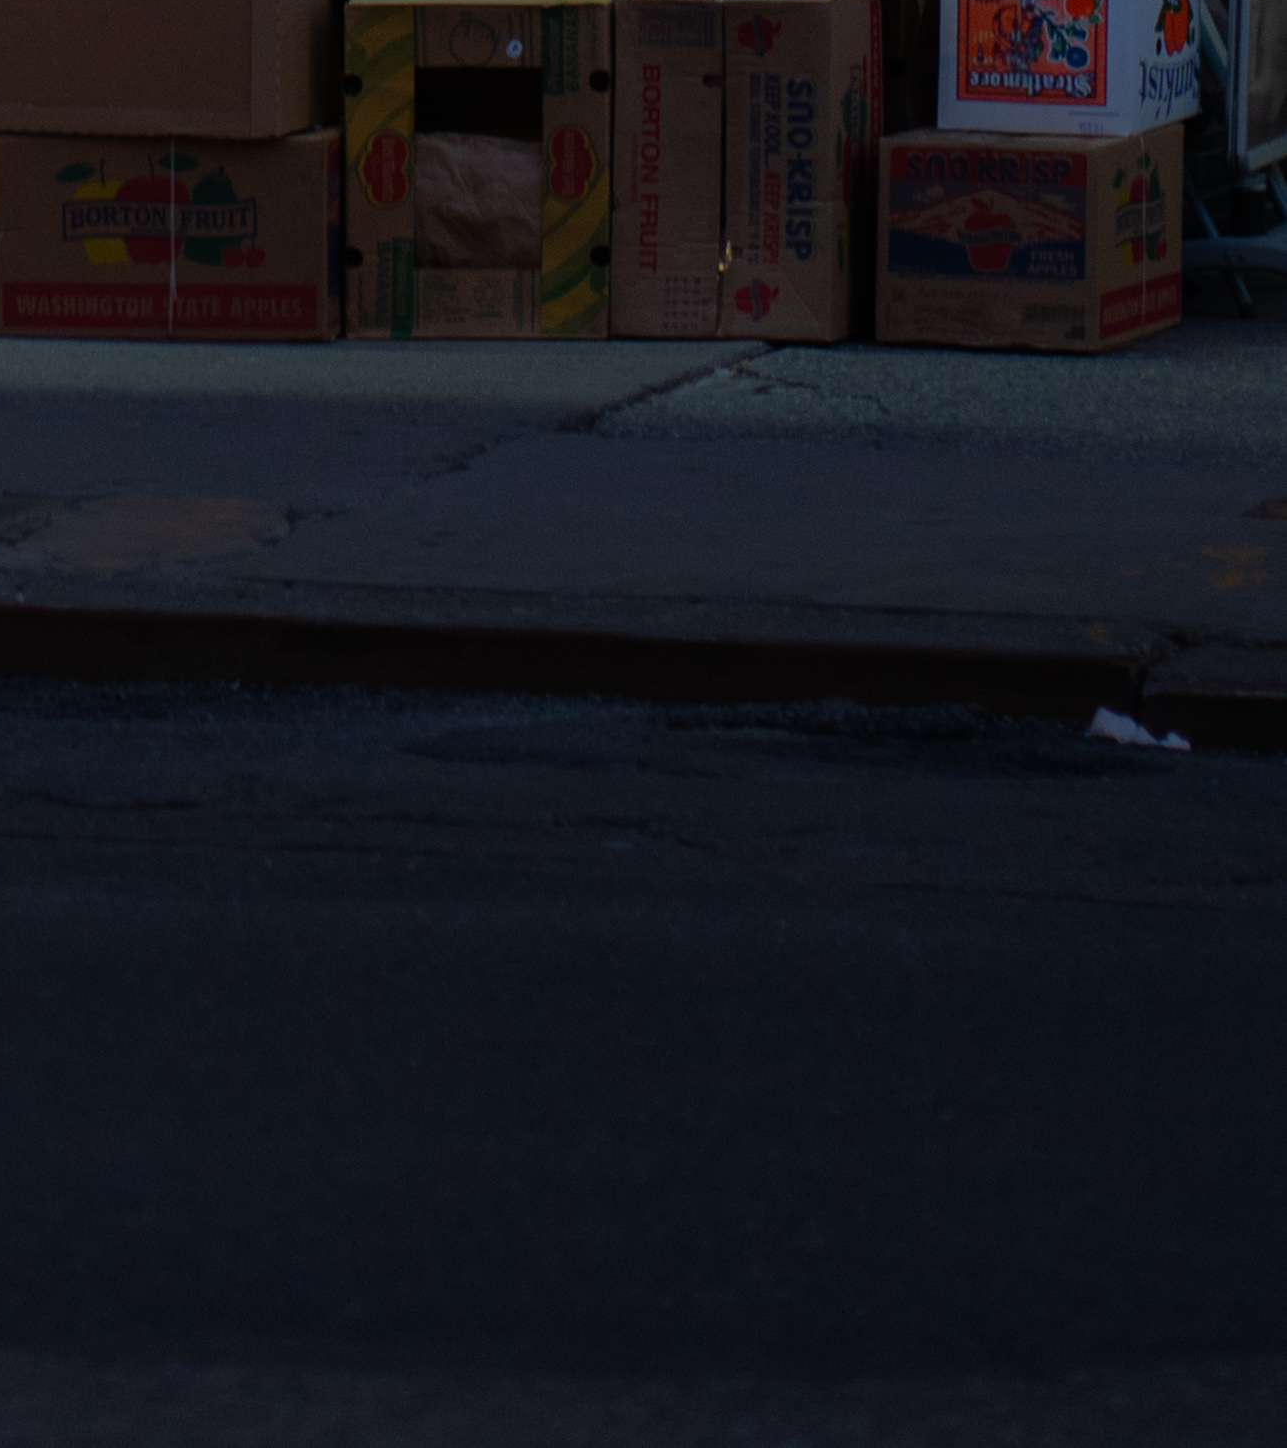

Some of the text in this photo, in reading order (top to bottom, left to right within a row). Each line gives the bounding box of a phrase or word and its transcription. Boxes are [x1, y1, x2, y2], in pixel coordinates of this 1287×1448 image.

[969, 69, 1093, 98] Strathmore
[639, 64, 662, 274] BORTON FRUIT
[70, 202, 252, 231] BORTON FRUIT
[1030, 249, 1076, 263] FRESH
[14, 294, 154, 318] WASHINGTON
[229, 297, 304, 319] APPLES
